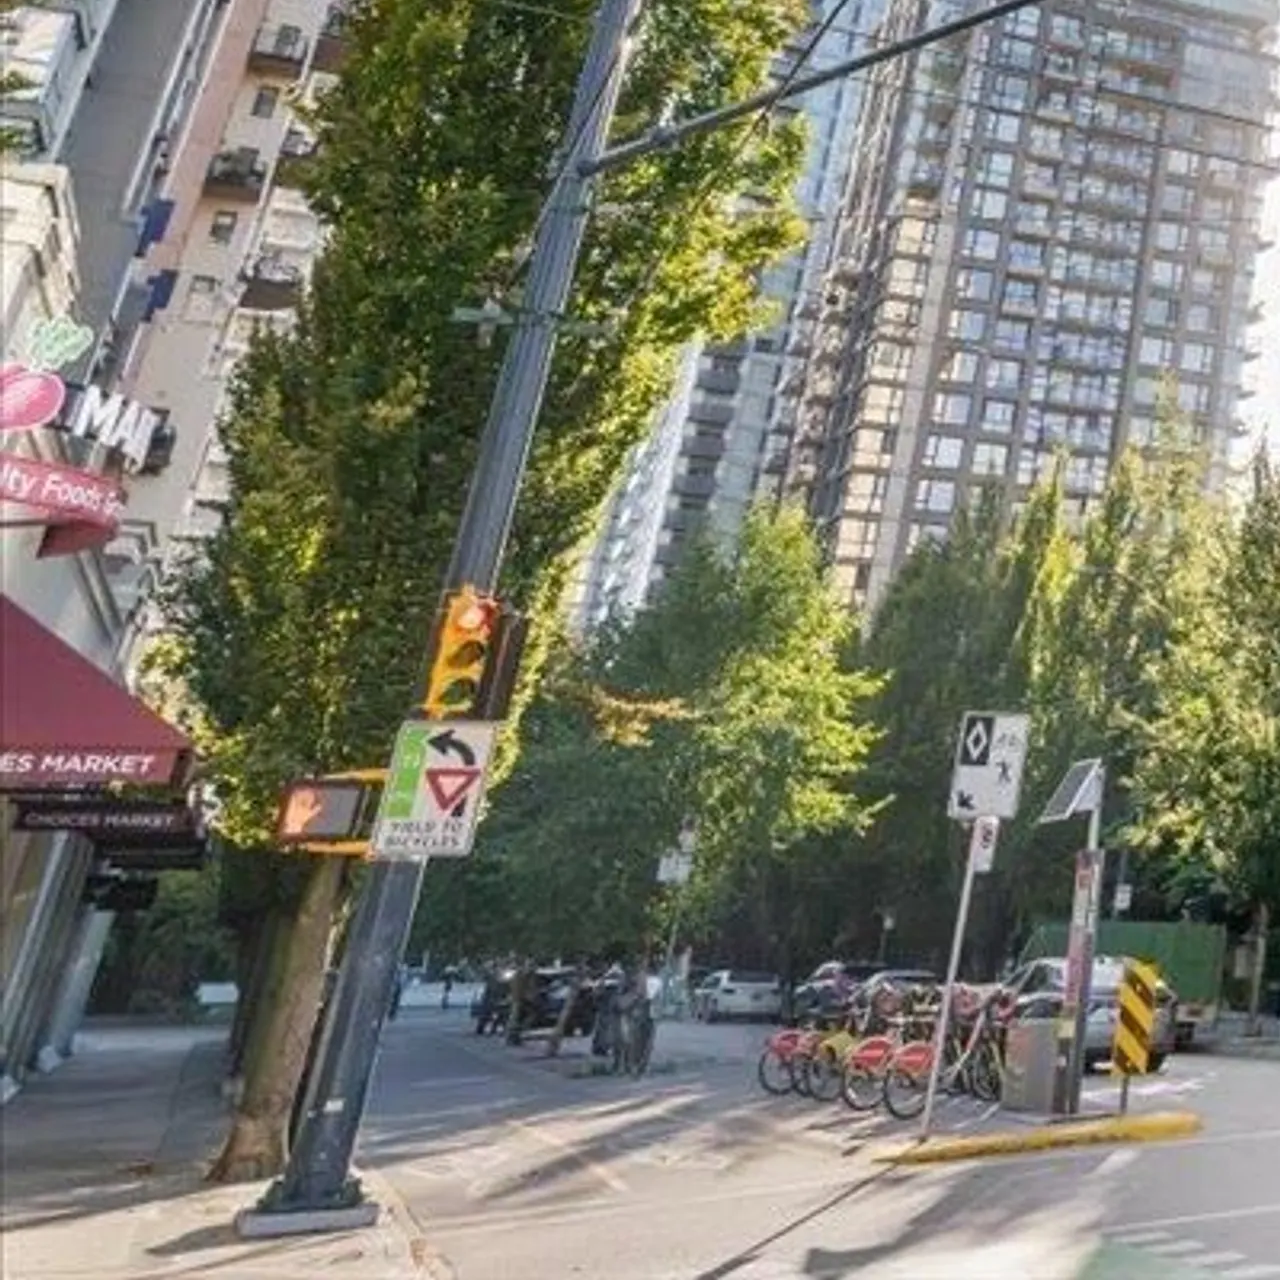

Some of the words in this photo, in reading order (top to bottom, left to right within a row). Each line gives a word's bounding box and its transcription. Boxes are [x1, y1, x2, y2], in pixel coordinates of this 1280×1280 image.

[40, 754, 155, 774] MARKET
[25, 812, 99, 827] CHOICES
[103, 813, 175, 828] MARKET
[390, 821, 437, 835] YIELD
[443, 821, 463, 835] TO
[384, 836, 461, 848] BICYCLES
